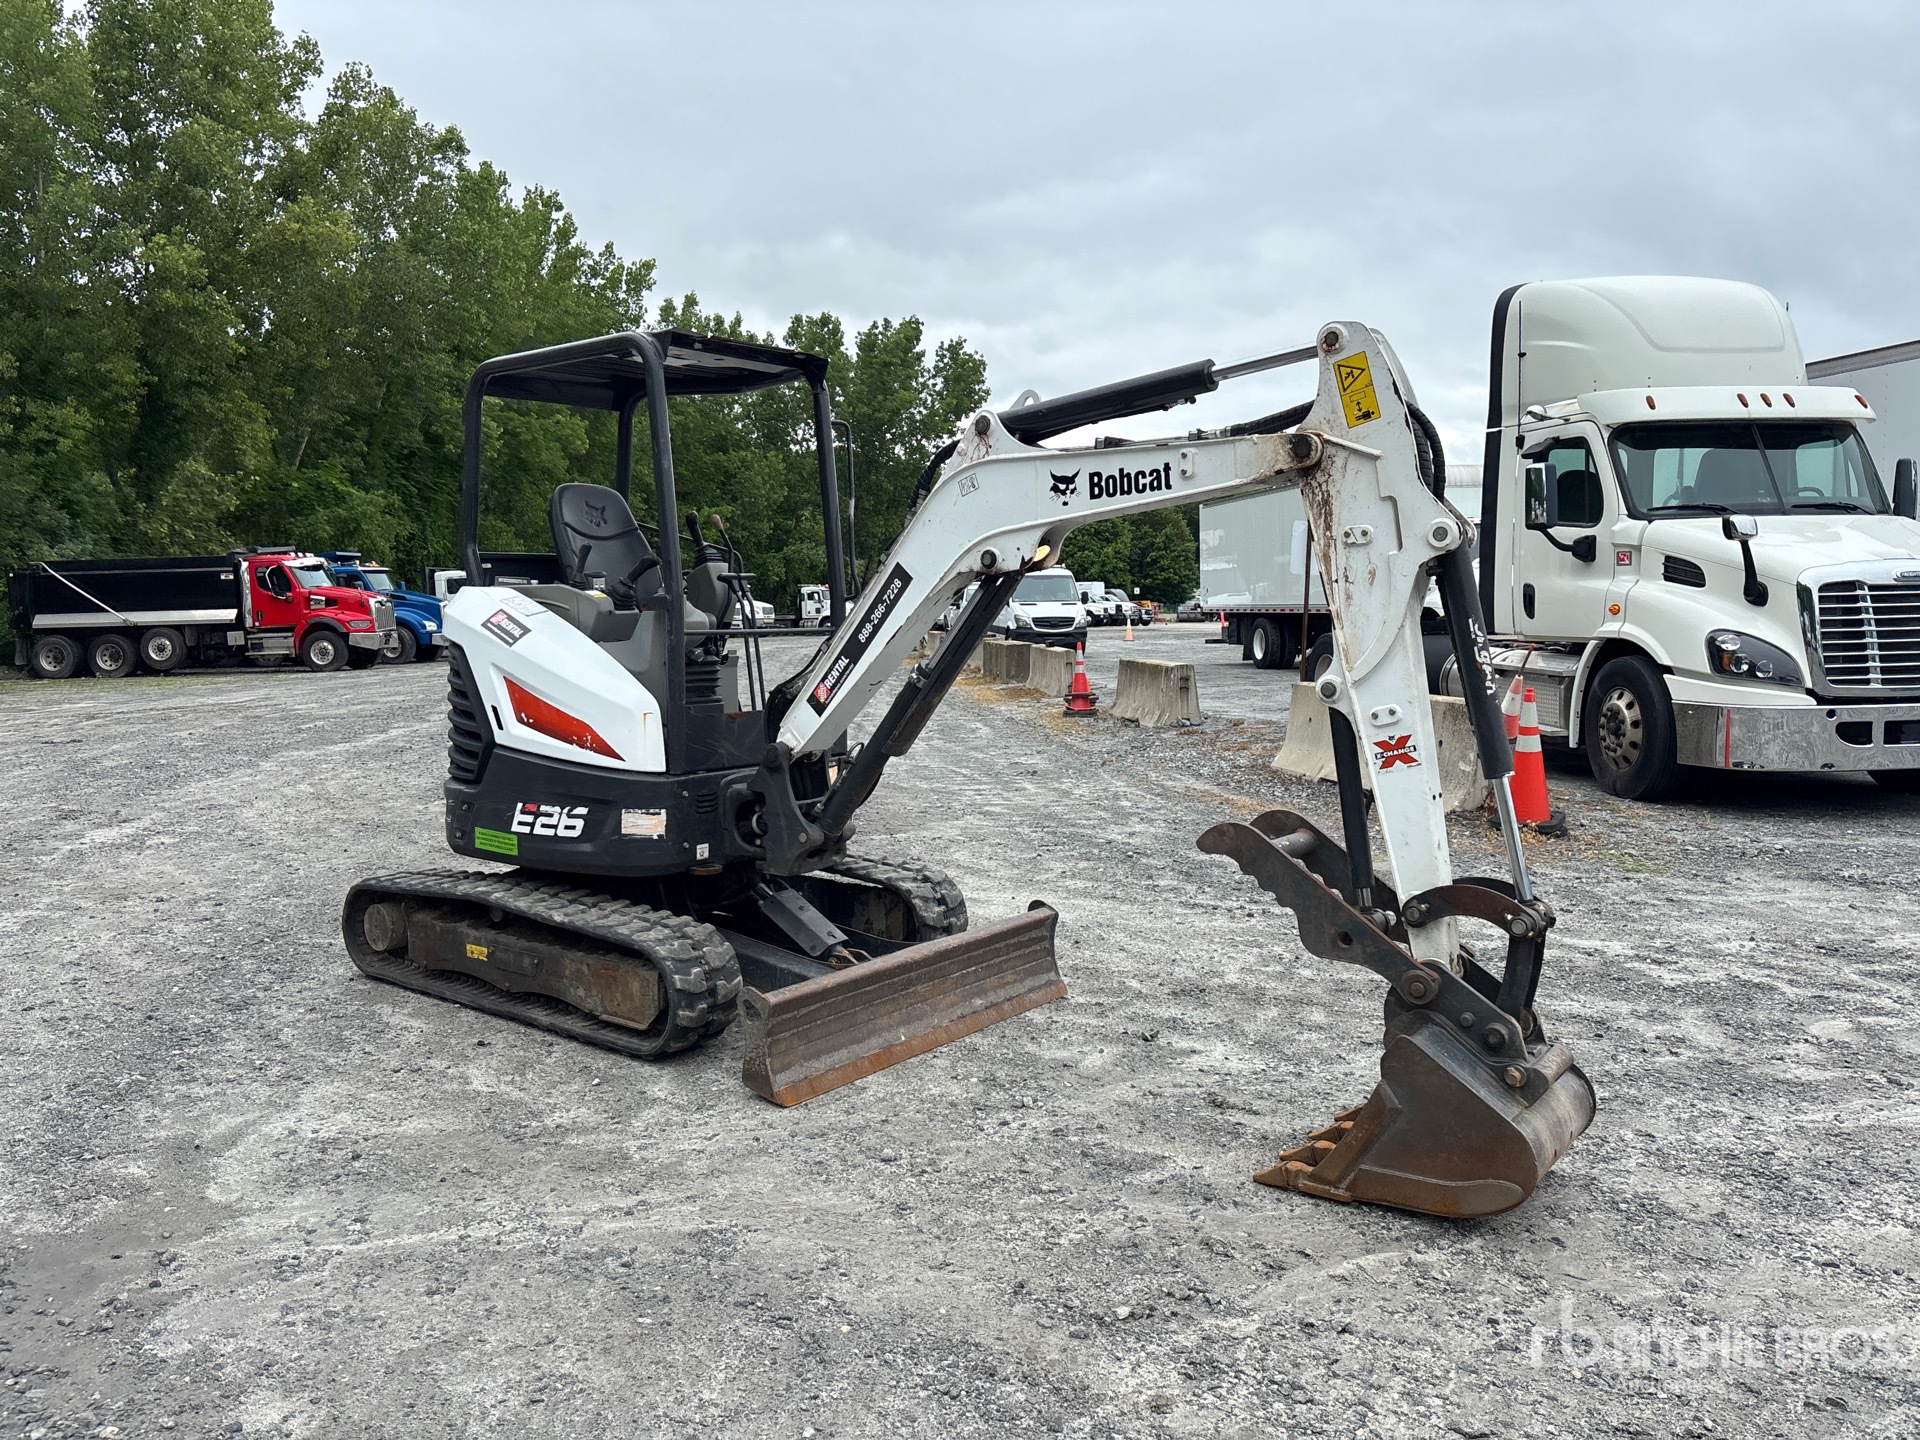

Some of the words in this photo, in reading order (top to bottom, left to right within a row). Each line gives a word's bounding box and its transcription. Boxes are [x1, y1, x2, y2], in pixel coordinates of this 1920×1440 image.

[1089, 462, 1172, 500] Bobcat
[499, 618, 524, 638] RENTAL
[858, 578, 902, 643] 888-266-7228
[824, 655, 850, 690] RENTAL
[510, 802, 589, 838] E26
